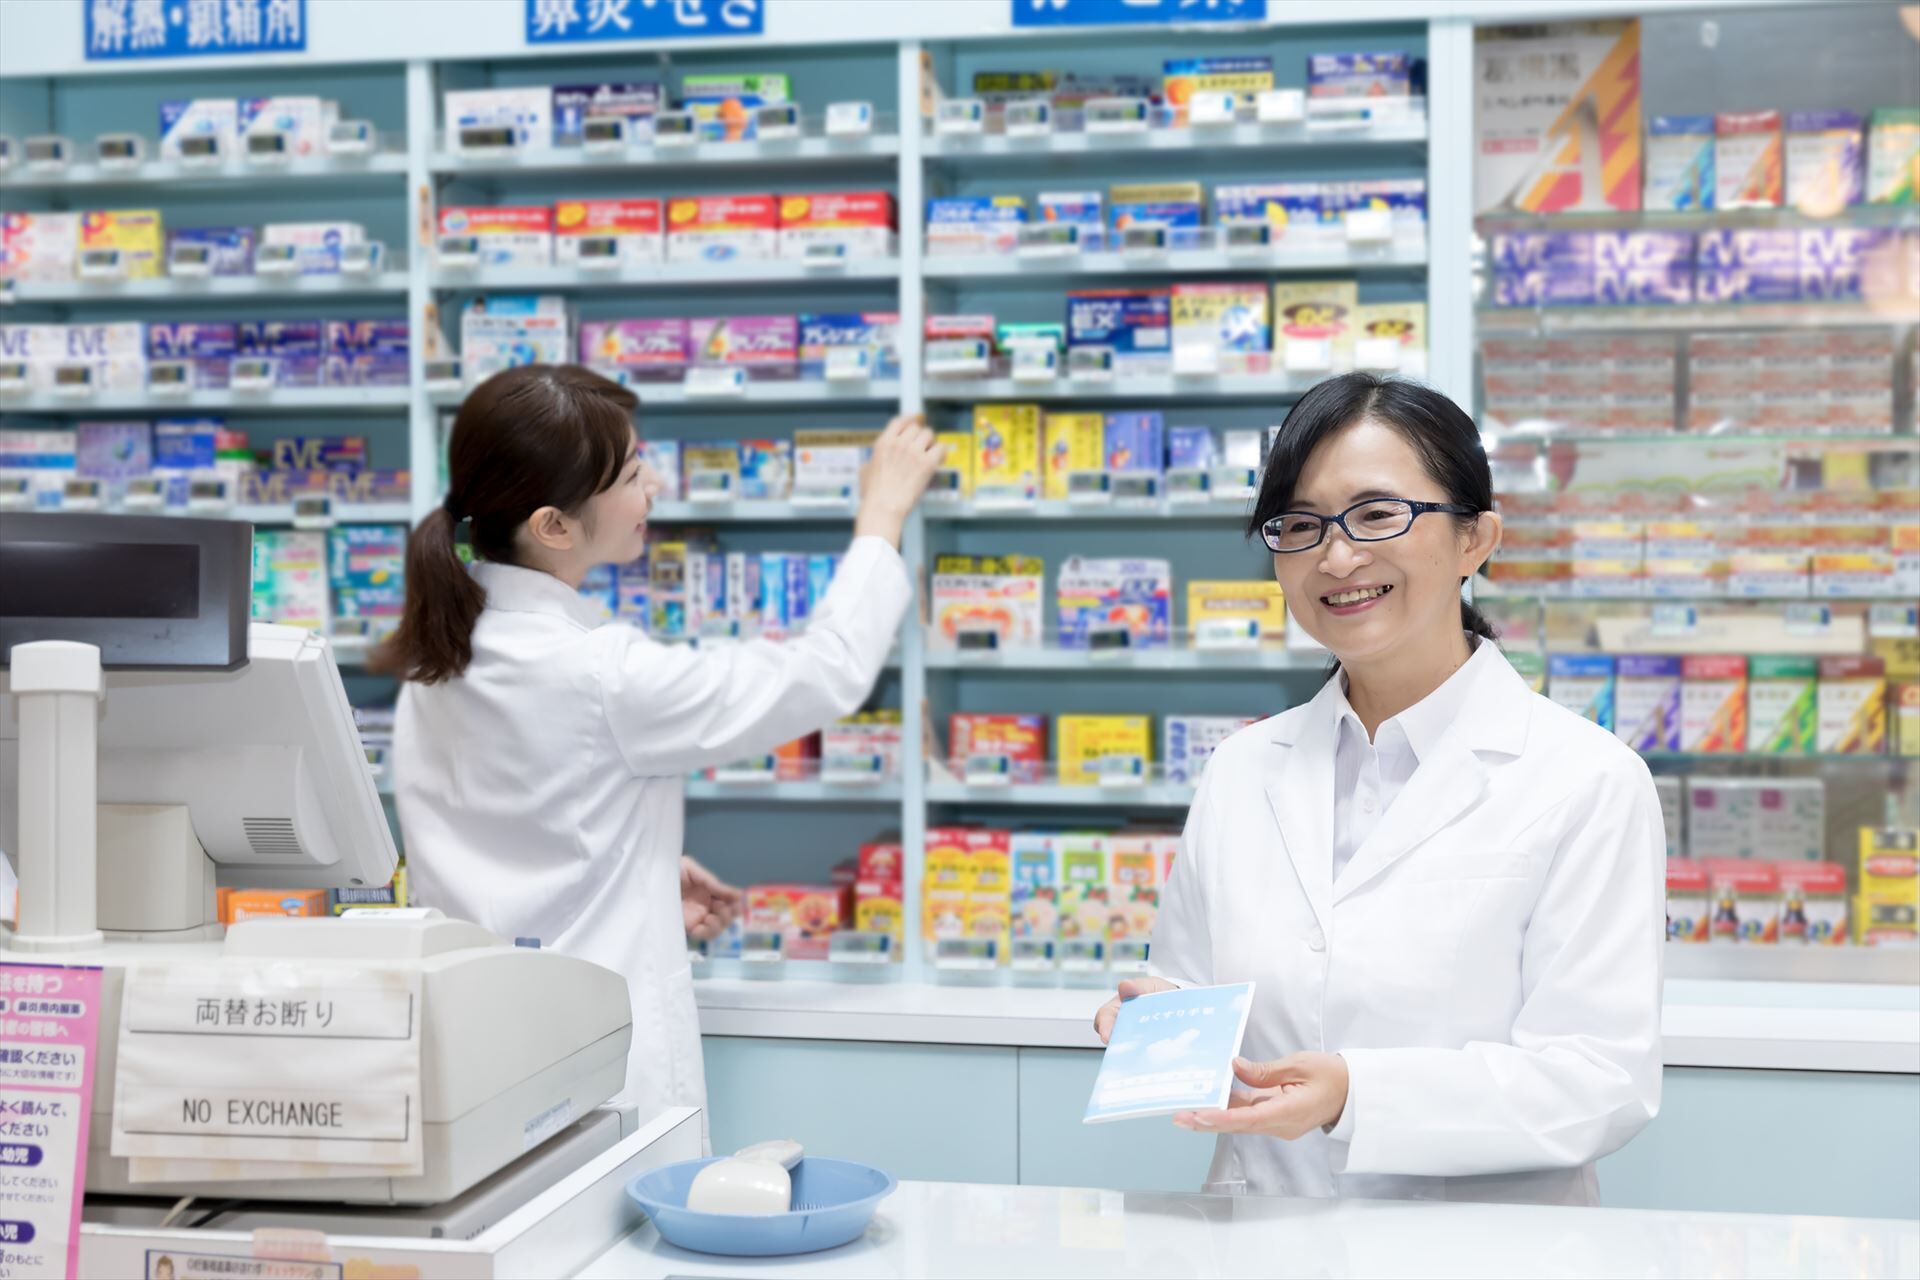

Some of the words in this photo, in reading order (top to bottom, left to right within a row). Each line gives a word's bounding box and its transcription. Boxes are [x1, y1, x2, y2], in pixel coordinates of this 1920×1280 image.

[67, 327, 107, 357] EVE
[151, 324, 198, 355] EVE
[327, 322, 377, 352] EVE
[274, 437, 327, 471] EVE
[239, 471, 290, 505] EVE
[328, 471, 377, 504] EVE
[196, 998, 334, 1028] 両替お断り
[0, 1019, 69, 1038] 者の皆様へ
[182, 1097, 212, 1124] NO
[228, 1099, 343, 1128] EXCHANGE
[0, 1147, 29, 1163] 幼児
[0, 1175, 58, 1189] してください
